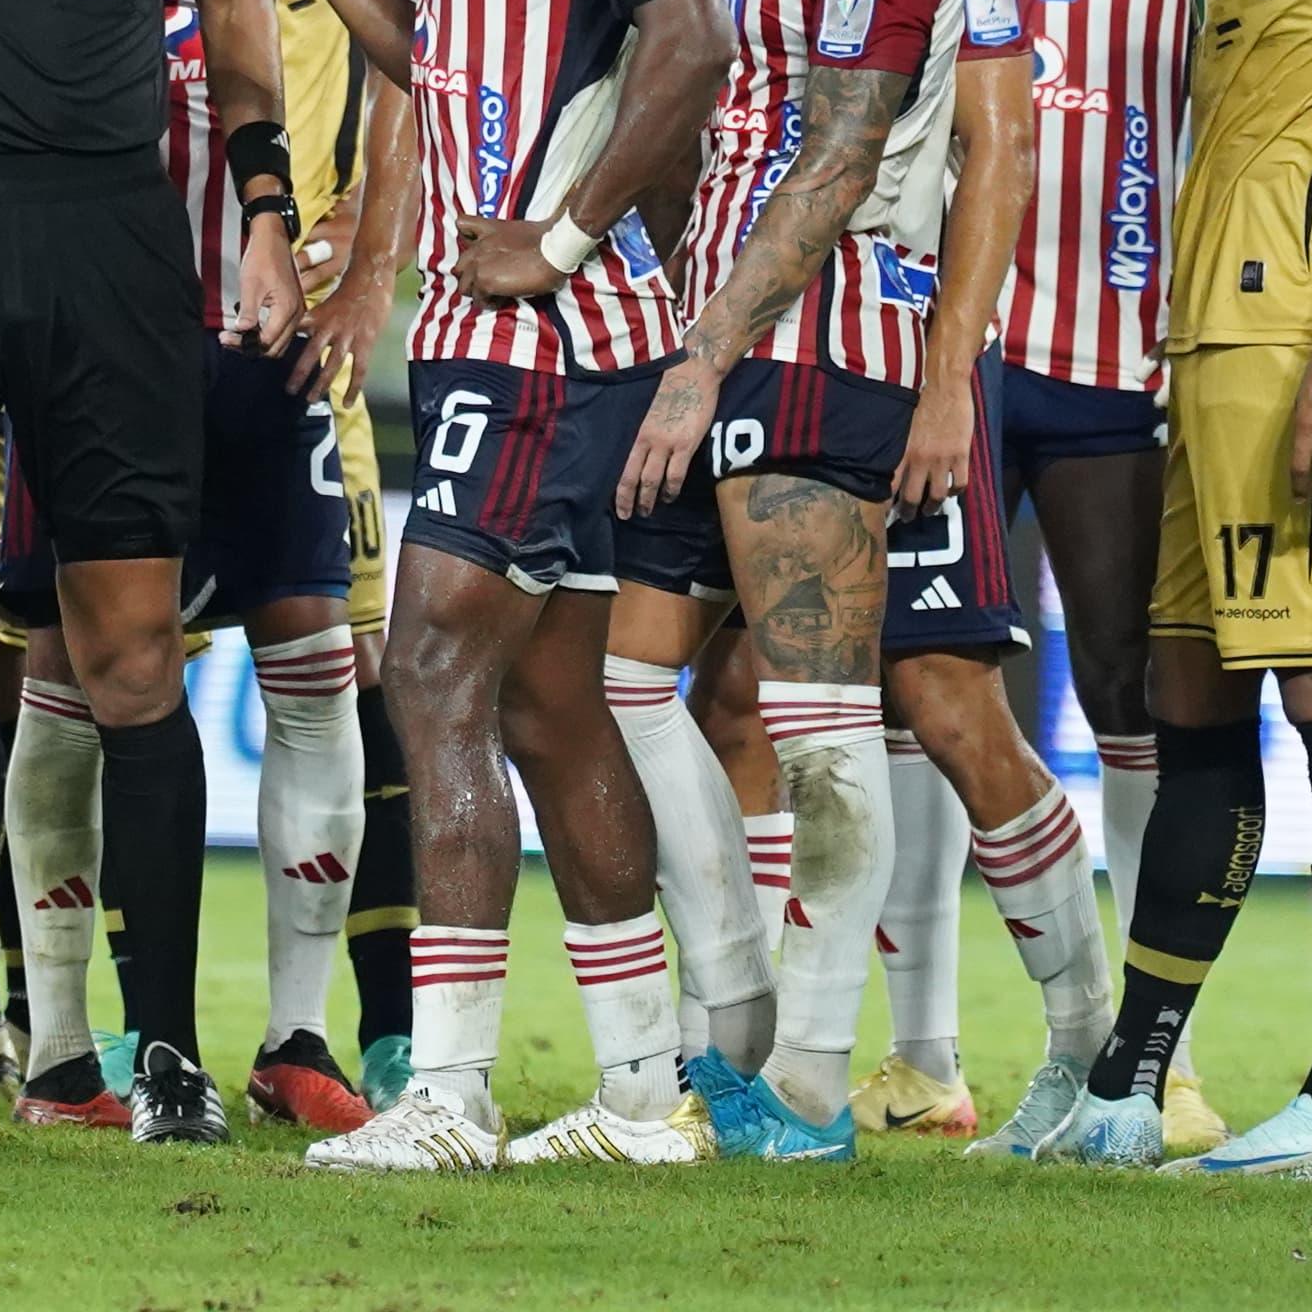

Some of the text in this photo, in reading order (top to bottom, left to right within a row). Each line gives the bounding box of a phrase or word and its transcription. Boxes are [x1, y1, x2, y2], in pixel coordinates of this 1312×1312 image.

[1108, 115, 1155, 288] Wplay.co
[429, 389, 493, 474] 6
[1214, 522, 1276, 601] 17
[1225, 606, 1291, 621] aerosport
